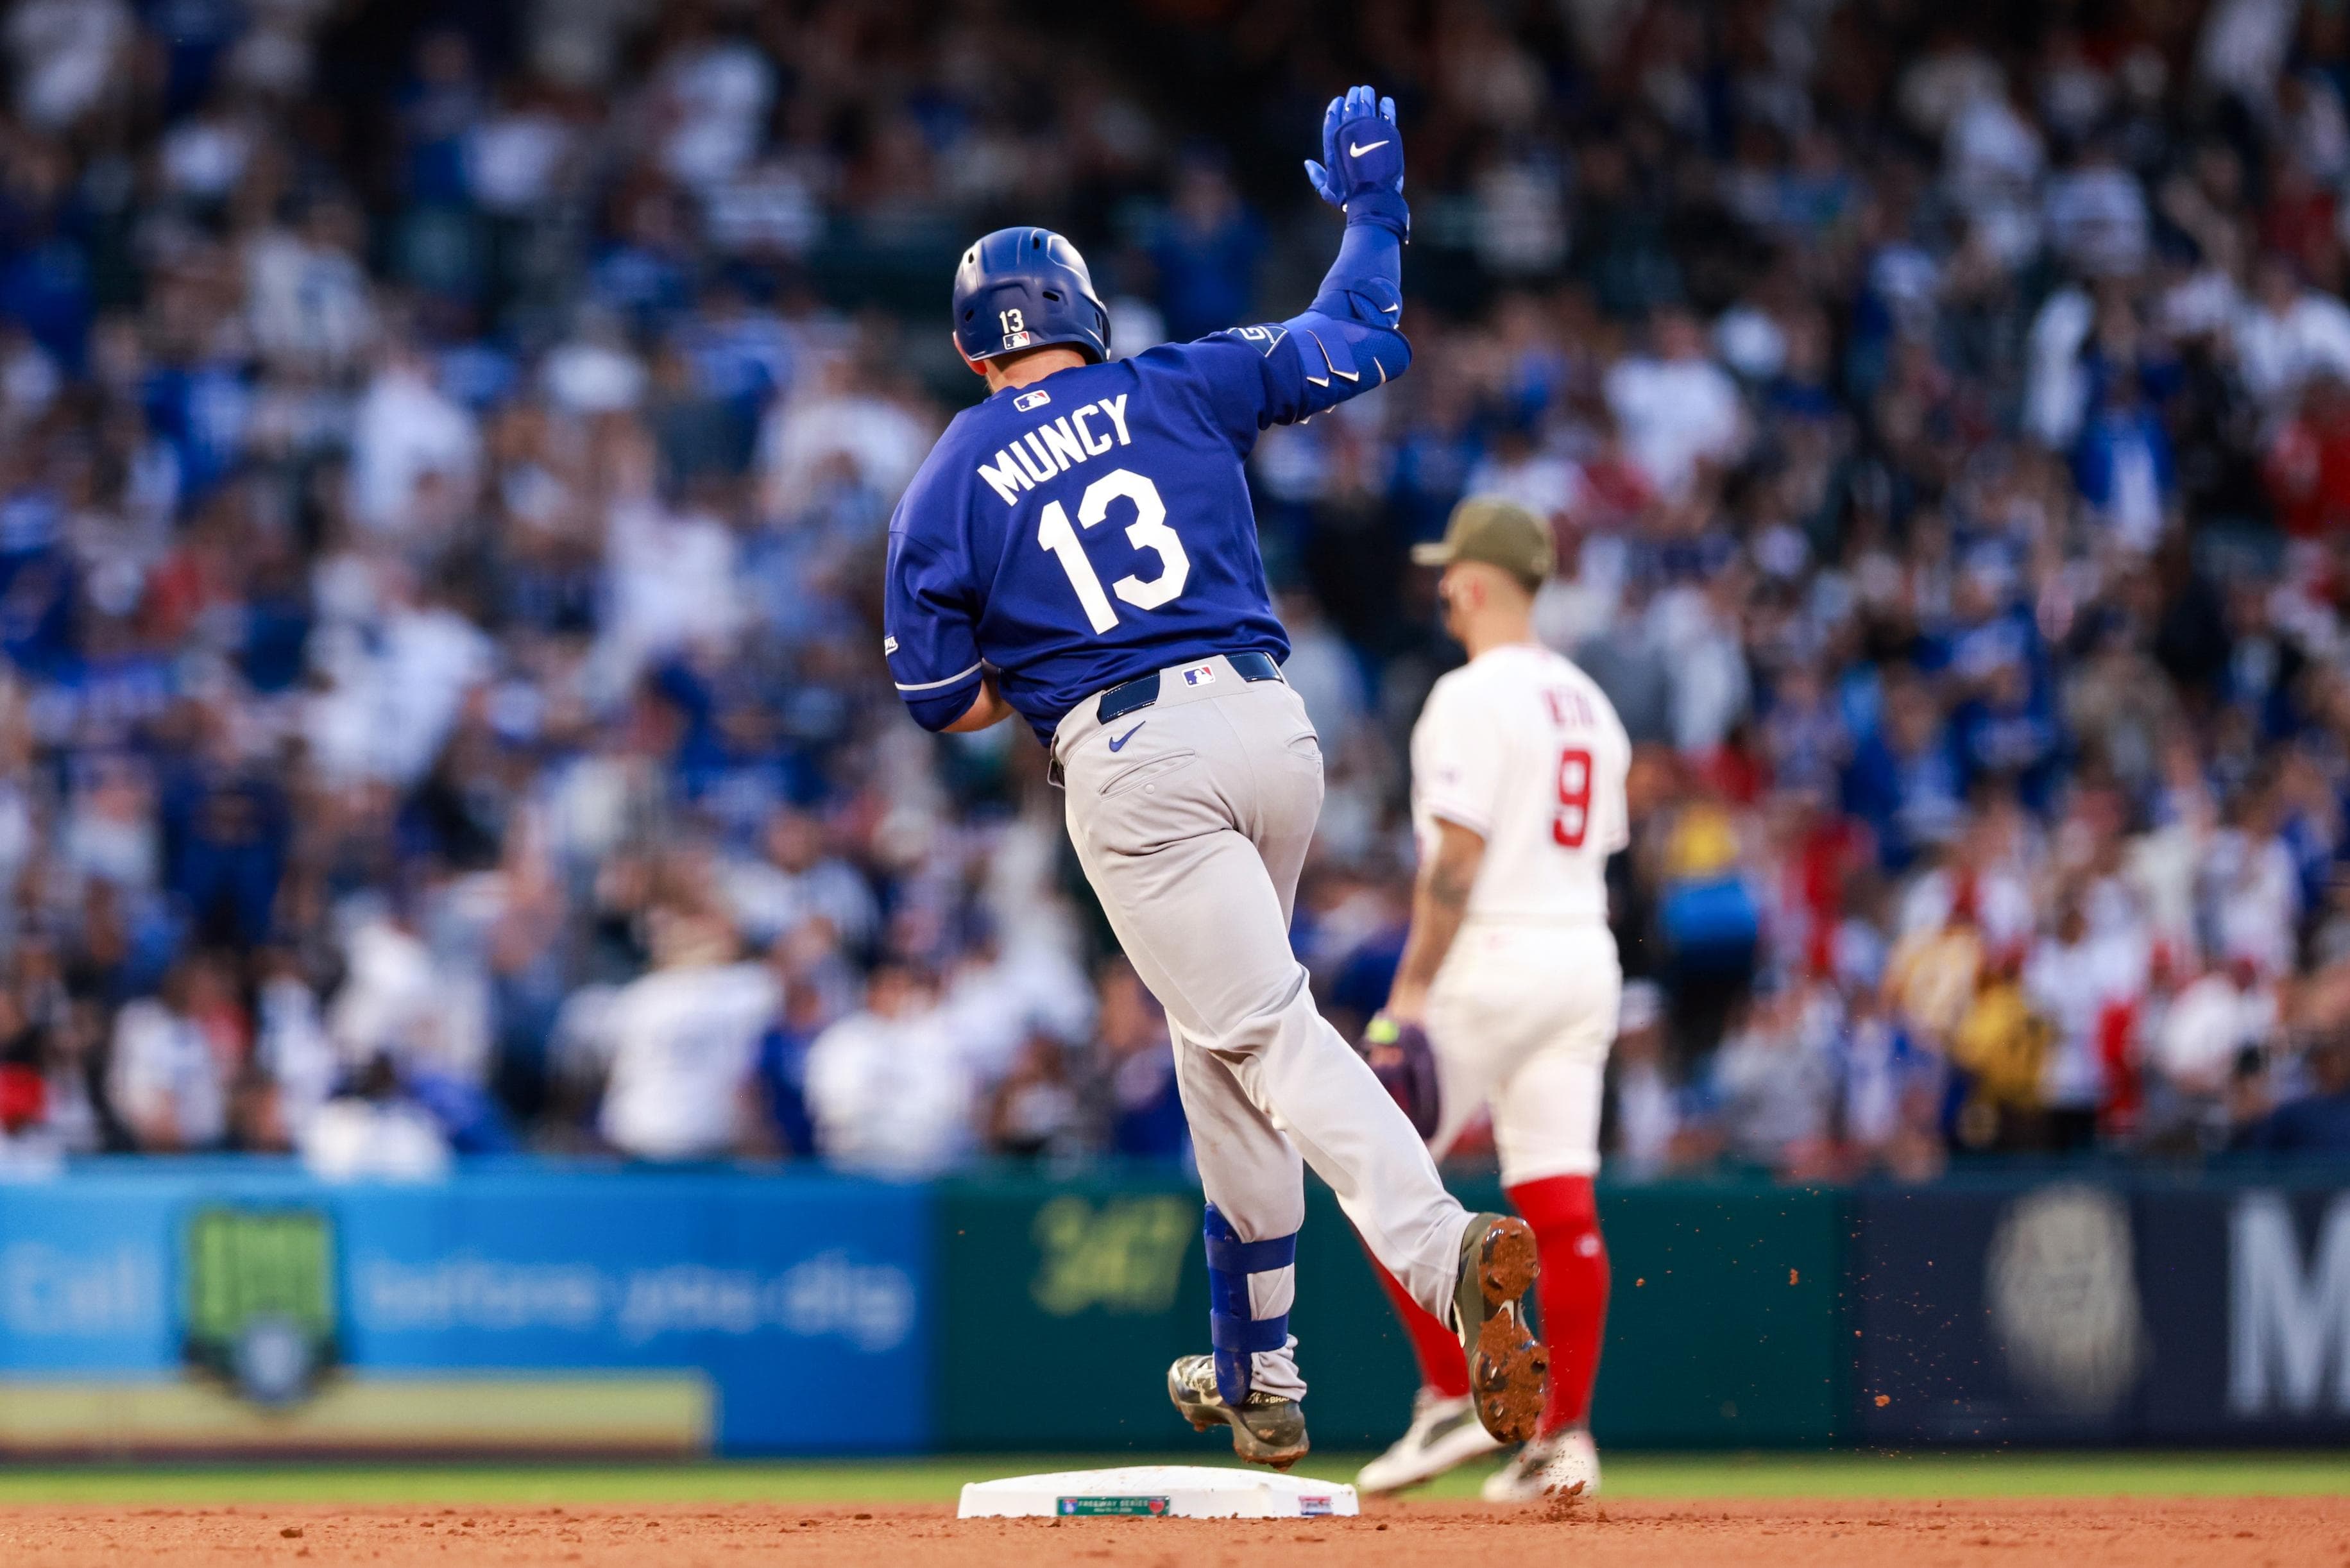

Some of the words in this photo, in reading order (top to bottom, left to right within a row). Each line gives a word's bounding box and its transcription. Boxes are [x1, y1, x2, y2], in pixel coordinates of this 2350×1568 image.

[999, 308, 1025, 334] 13
[978, 394, 1129, 506] MUNCY
[1037, 468, 1191, 636] 13
[1553, 749, 1592, 849] 9
